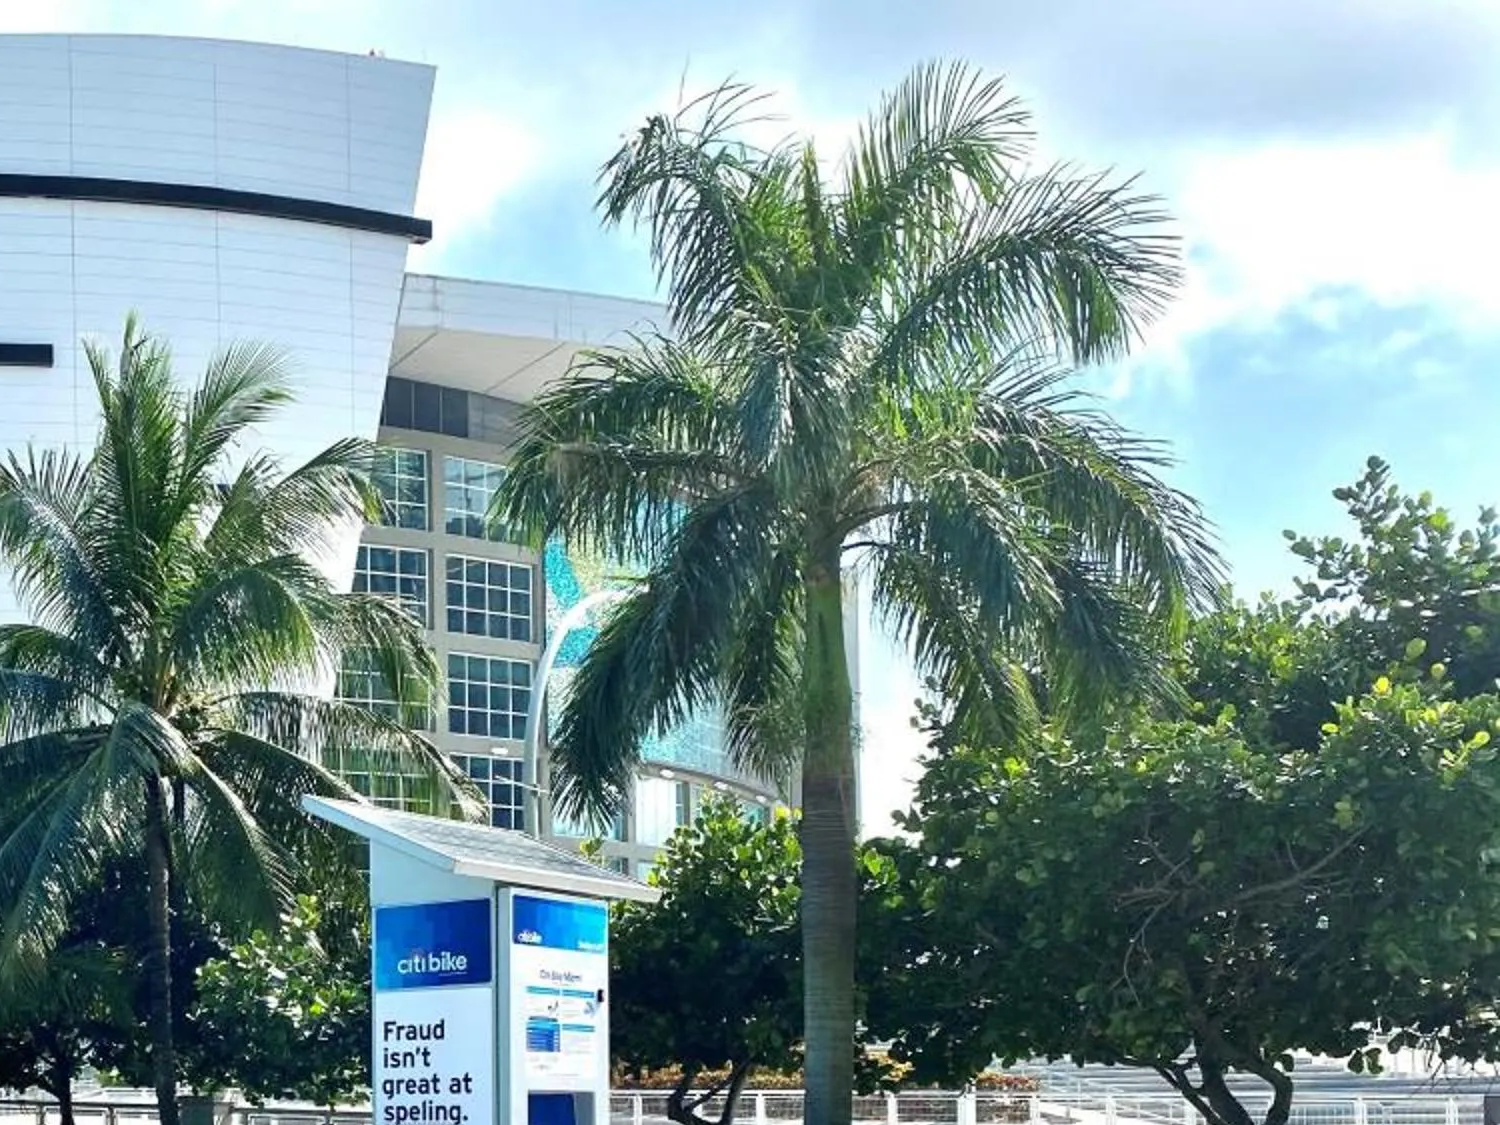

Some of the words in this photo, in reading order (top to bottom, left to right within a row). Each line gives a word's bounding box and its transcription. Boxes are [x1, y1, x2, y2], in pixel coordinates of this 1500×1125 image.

[383, 1019, 445, 1042] Fraud
[383, 1047, 431, 1068] isn't
[382, 1073, 441, 1100] great
[449, 1072, 473, 1095] at
[383, 1100, 469, 1125] speling.
